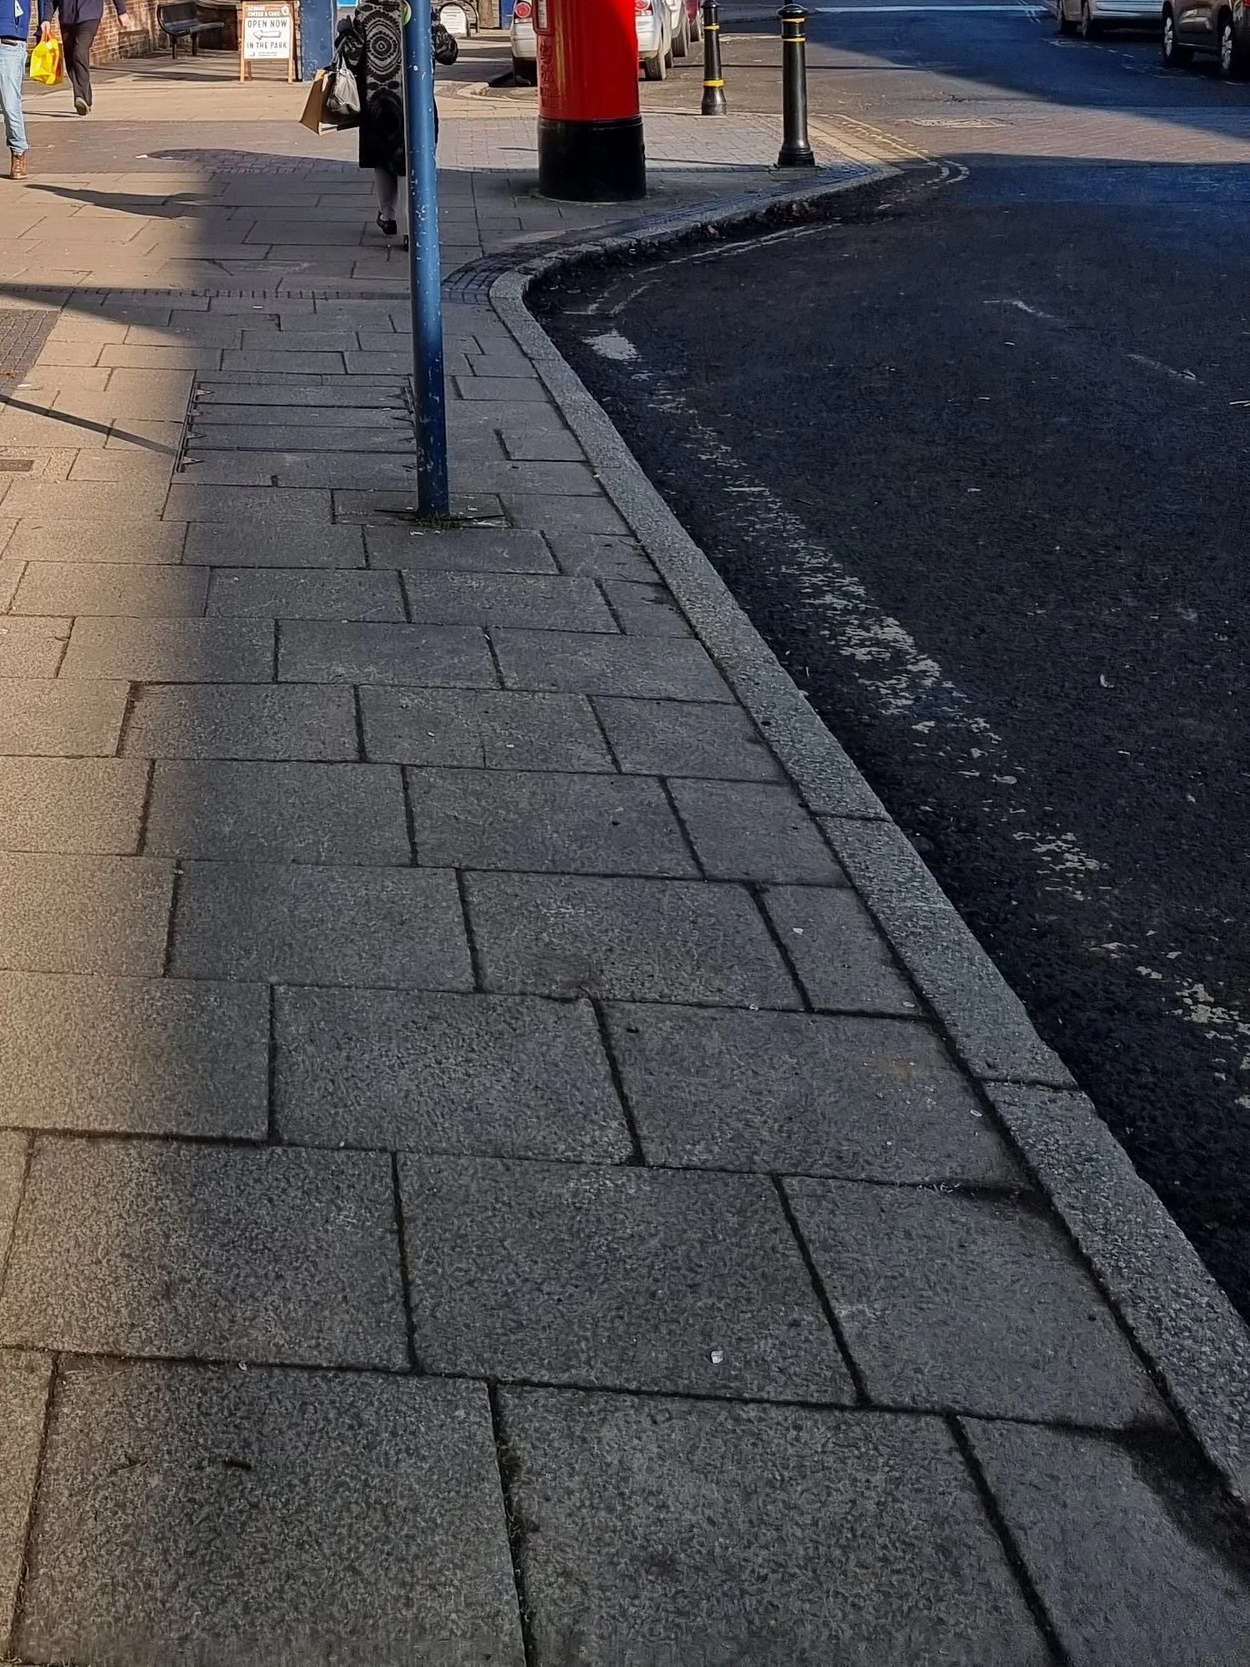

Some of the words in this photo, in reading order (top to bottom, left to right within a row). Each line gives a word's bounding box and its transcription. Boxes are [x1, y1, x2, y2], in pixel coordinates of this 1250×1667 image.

[247, 19, 268, 28] OPEN
[269, 19, 288, 28] NOW
[256, 41, 269, 49] THE
[270, 41, 288, 49] PARK
